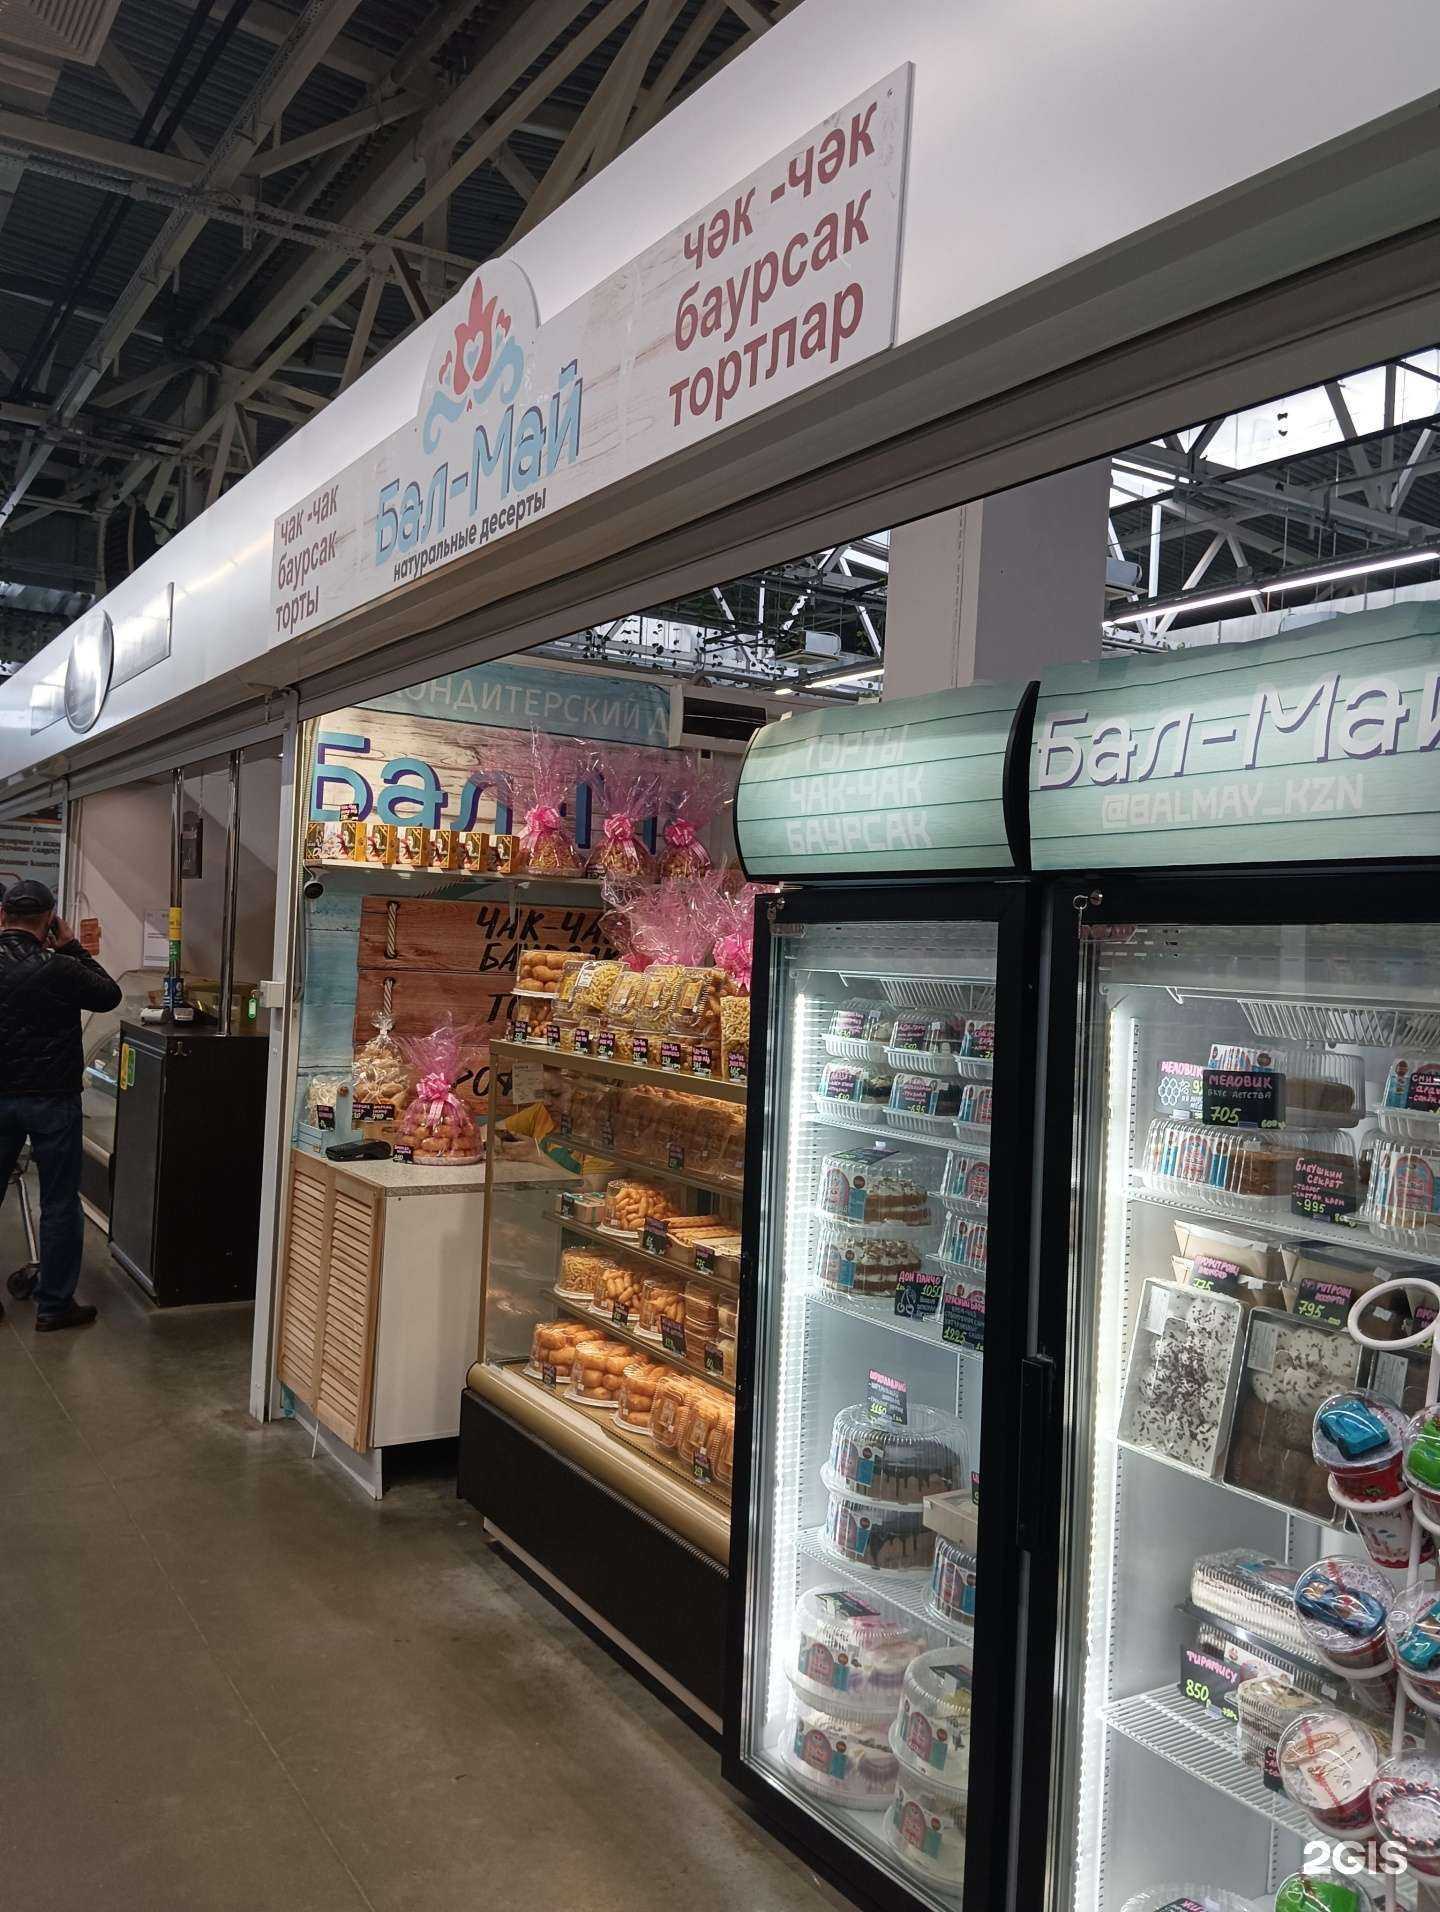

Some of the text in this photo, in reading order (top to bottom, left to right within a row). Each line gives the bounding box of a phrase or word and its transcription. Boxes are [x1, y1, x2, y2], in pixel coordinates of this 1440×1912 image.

[683, 187, 756, 269] чәк
[675, 189, 872, 352] баурсак
[668, 282, 864, 427] тортлар
[281, 518, 303, 547] чак
[393, 487, 547, 582] натуральные десерты
[277, 530, 337, 590] баурсак
[276, 585, 319, 635] торты
[397, 676, 640, 729] ОНДИТЕРСКИЙ
[789, 766, 927, 813] ЧАК-ЧАК
[1101, 774, 1364, 829] @BALMAY_KZN
[784, 810, 935, 855] БАУРСАК
[1208, 1074, 1272, 1090] МЕДОВИК
[1210, 1106, 1242, 1124] 705
[899, 1270, 915, 1283] ДОН
[1186, 1649, 1239, 1684] ТИРАМИСУ
